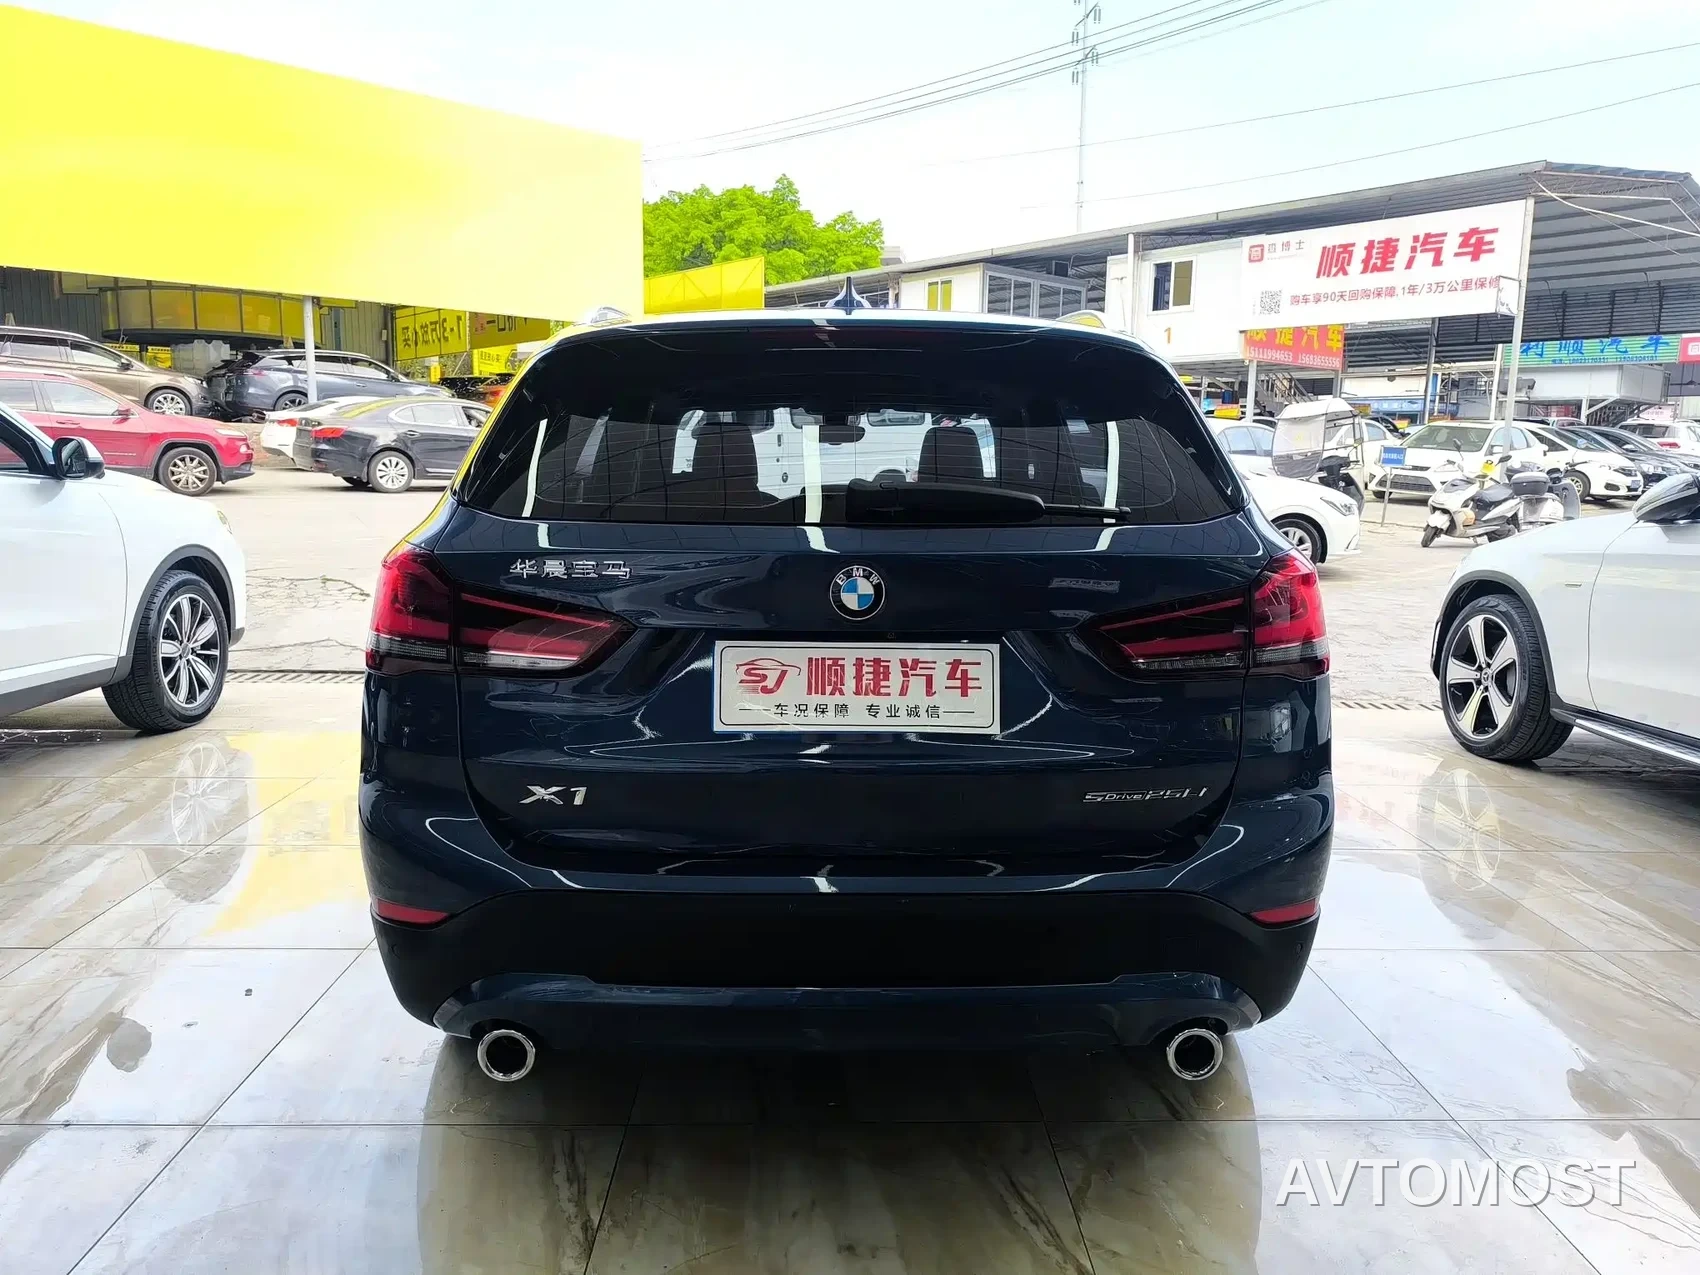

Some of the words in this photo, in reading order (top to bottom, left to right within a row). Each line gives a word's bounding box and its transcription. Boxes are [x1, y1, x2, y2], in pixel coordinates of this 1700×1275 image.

[1316, 227, 1499, 278] 顺捷汽车
[509, 558, 632, 579] 华晨宝马
[835, 567, 880, 586] BMW
[806, 656, 982, 697] 顺捷汽车
[773, 703, 850, 718] 车况保障
[865, 703, 941, 719] 专业诚信
[519, 785, 588, 805] X1
